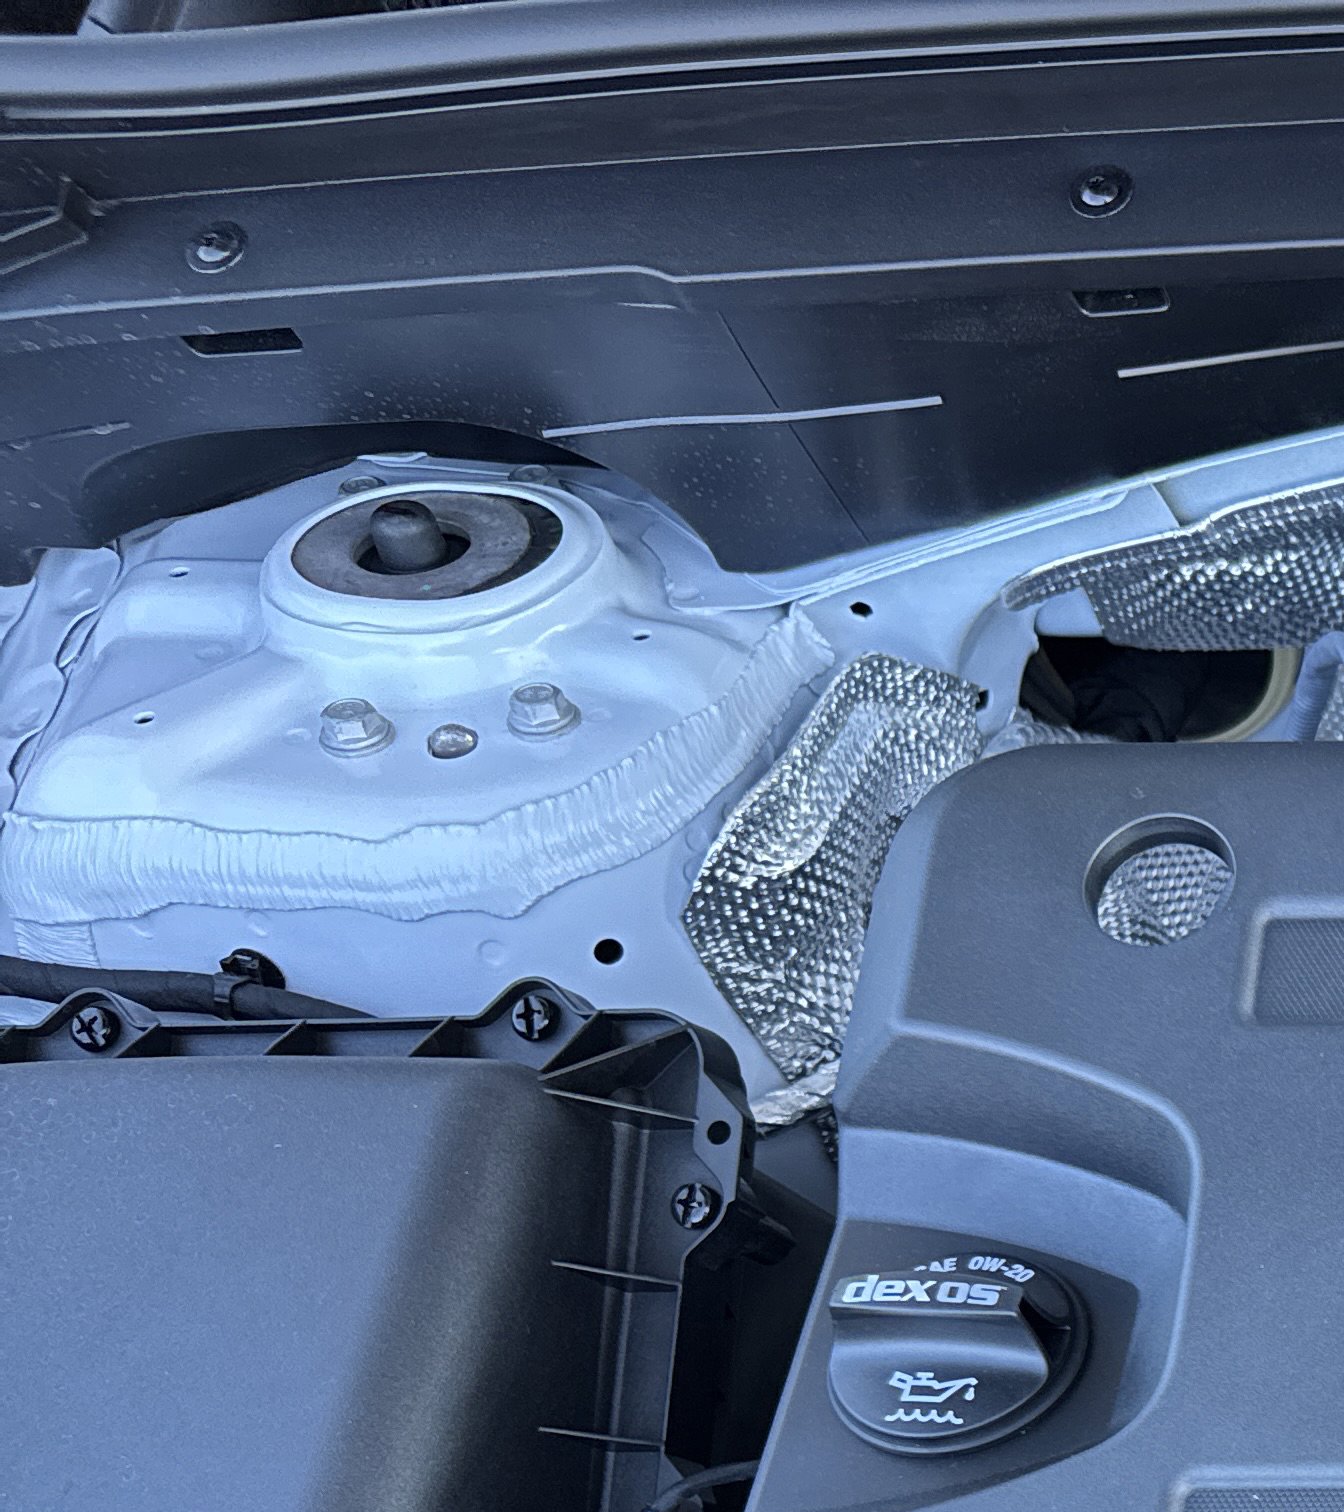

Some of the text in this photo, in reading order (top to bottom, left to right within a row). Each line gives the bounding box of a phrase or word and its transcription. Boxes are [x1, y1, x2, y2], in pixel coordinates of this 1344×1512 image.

[913, 1256, 1036, 1284] AE 0W-20
[842, 1274, 1004, 1306] dexos
